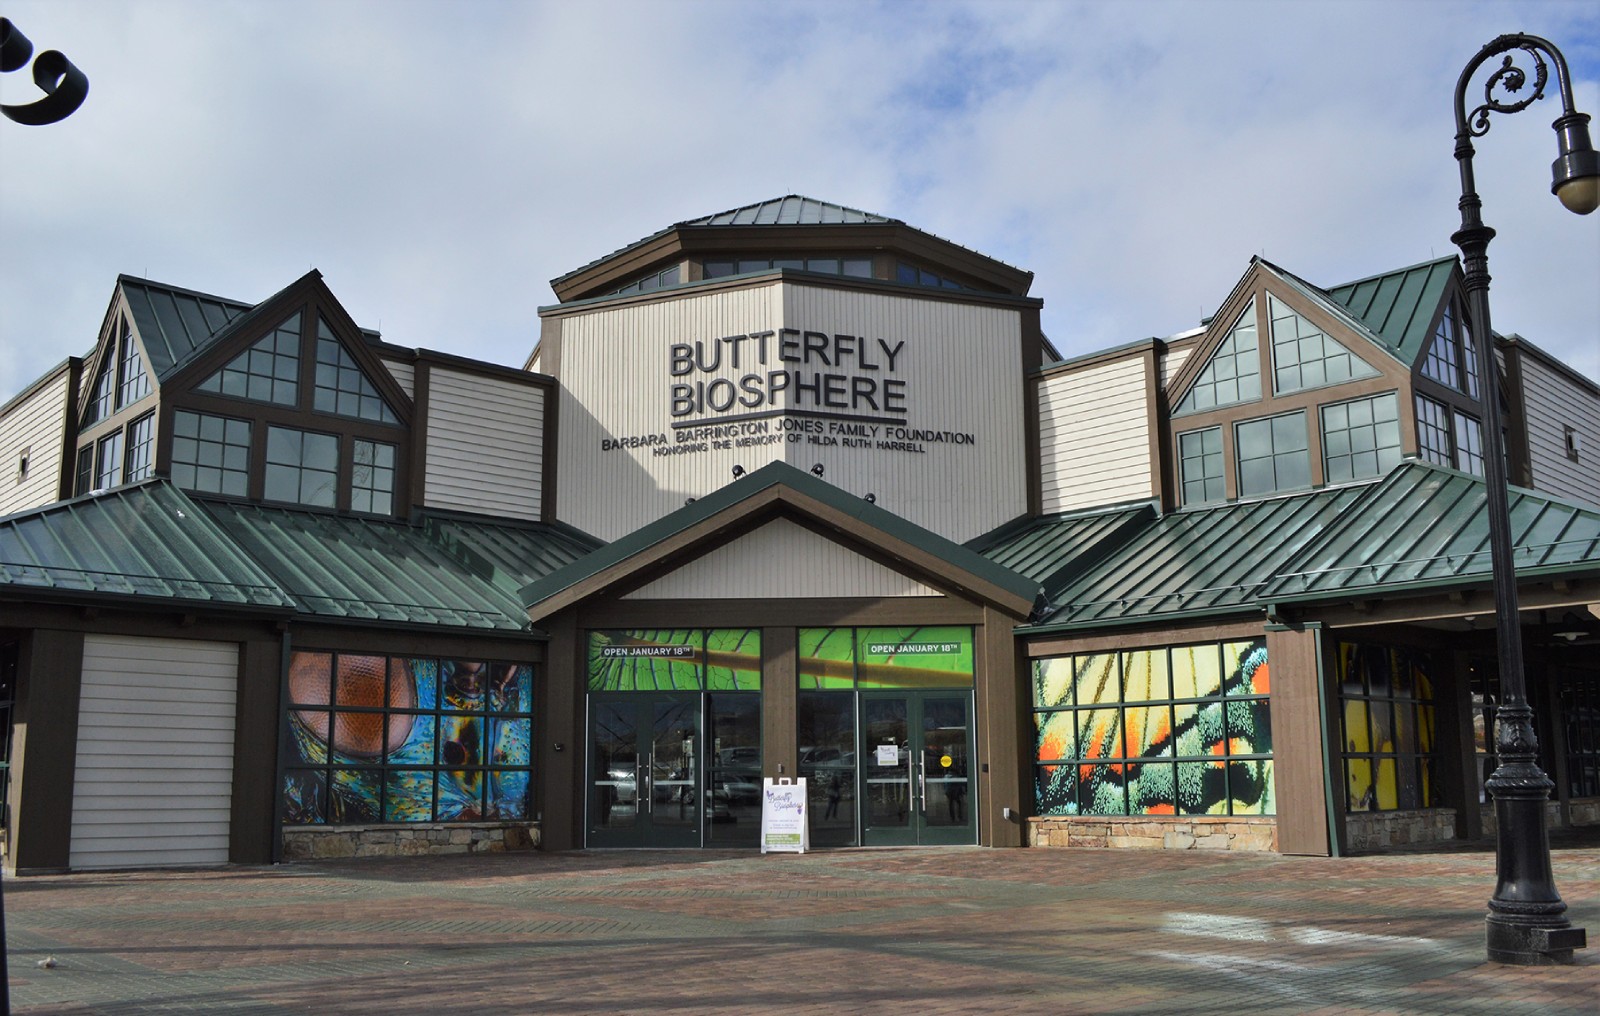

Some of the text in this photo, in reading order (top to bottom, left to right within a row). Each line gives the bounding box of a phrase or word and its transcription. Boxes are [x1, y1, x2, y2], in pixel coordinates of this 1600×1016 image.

[670, 328, 905, 377] BUTTERFLY
[670, 370, 907, 417] BIOSPHERE
[602, 418, 975, 451] BARBARA BARRINGTON JONES FAMILY FOUNDATION
[653, 433, 925, 457] HONORING THE MEMORY OF HILDA RUTH HARRELL
[604, 647, 690, 656] OPEN JANUARY 18TH
[871, 644, 958, 653] OPEN JANUARY 18TH
